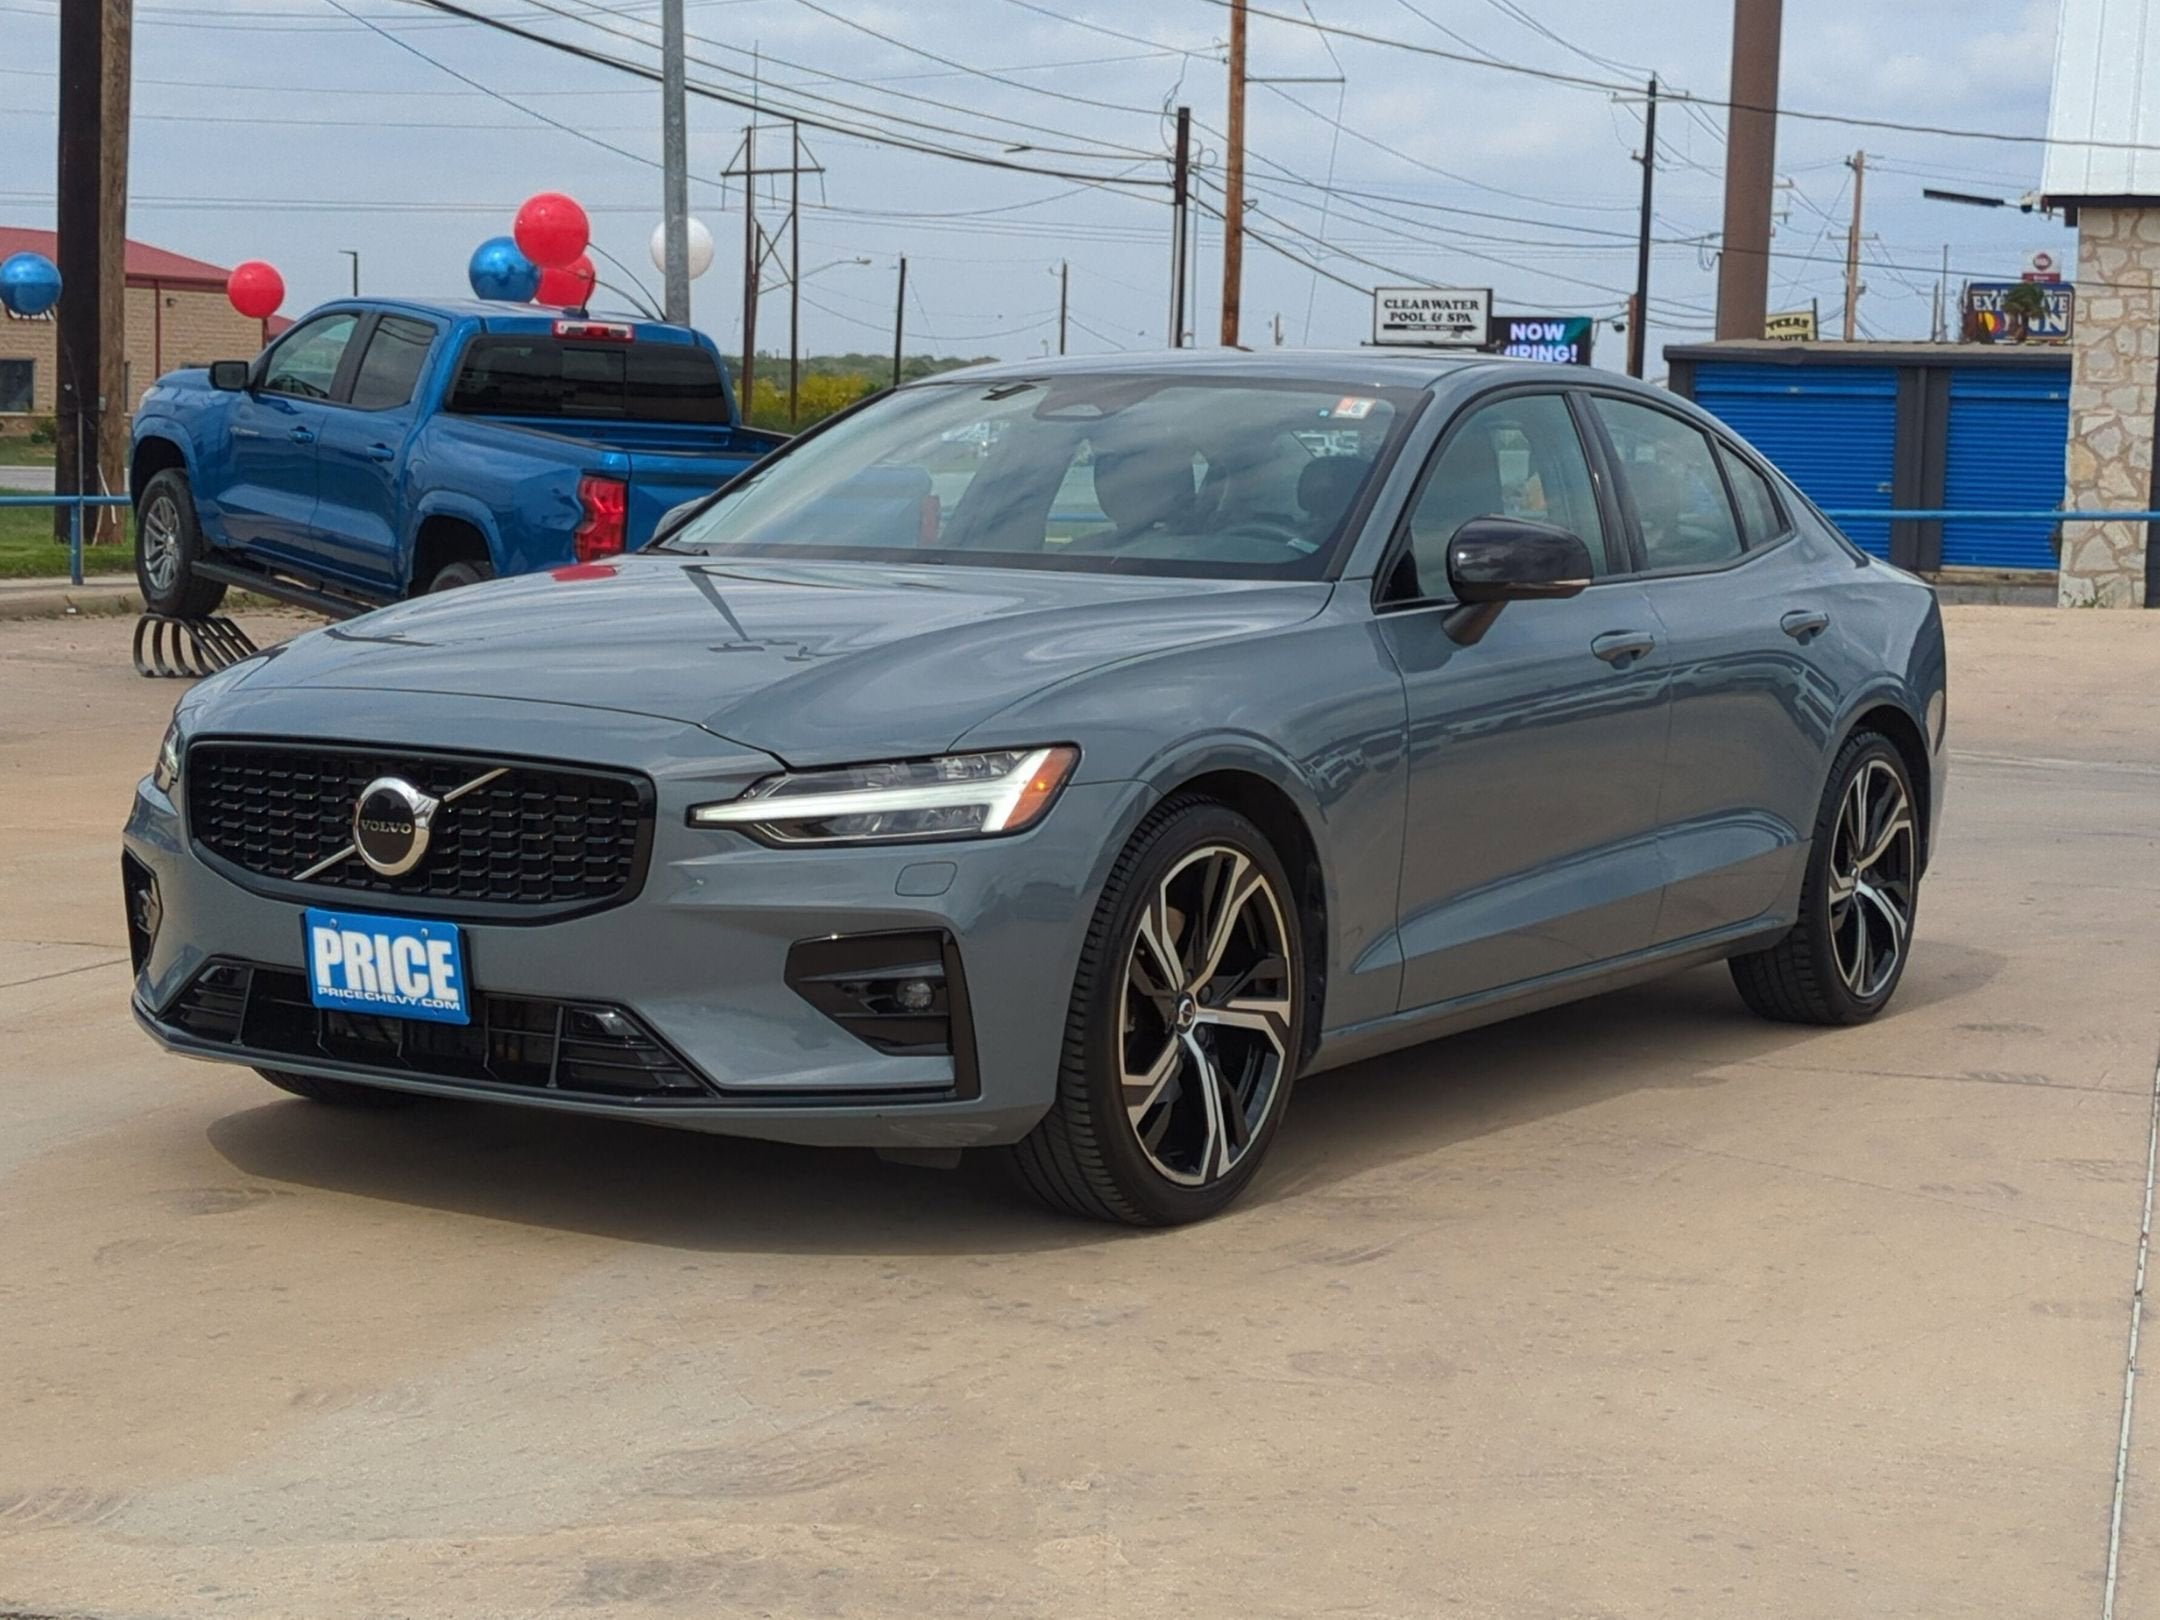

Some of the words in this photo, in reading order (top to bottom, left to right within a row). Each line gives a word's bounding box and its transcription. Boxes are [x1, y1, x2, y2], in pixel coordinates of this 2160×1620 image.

[1384, 299, 1479, 310] CLEARWATER
[1390, 312, 1426, 322] POOL
[1447, 313, 1472, 323] SPA
[1510, 323, 1565, 341] NOW
[361, 820, 412, 834] VOLVO
[313, 926, 459, 1001] PRICE
[317, 985, 460, 1010] PRICECHEVY.COM
